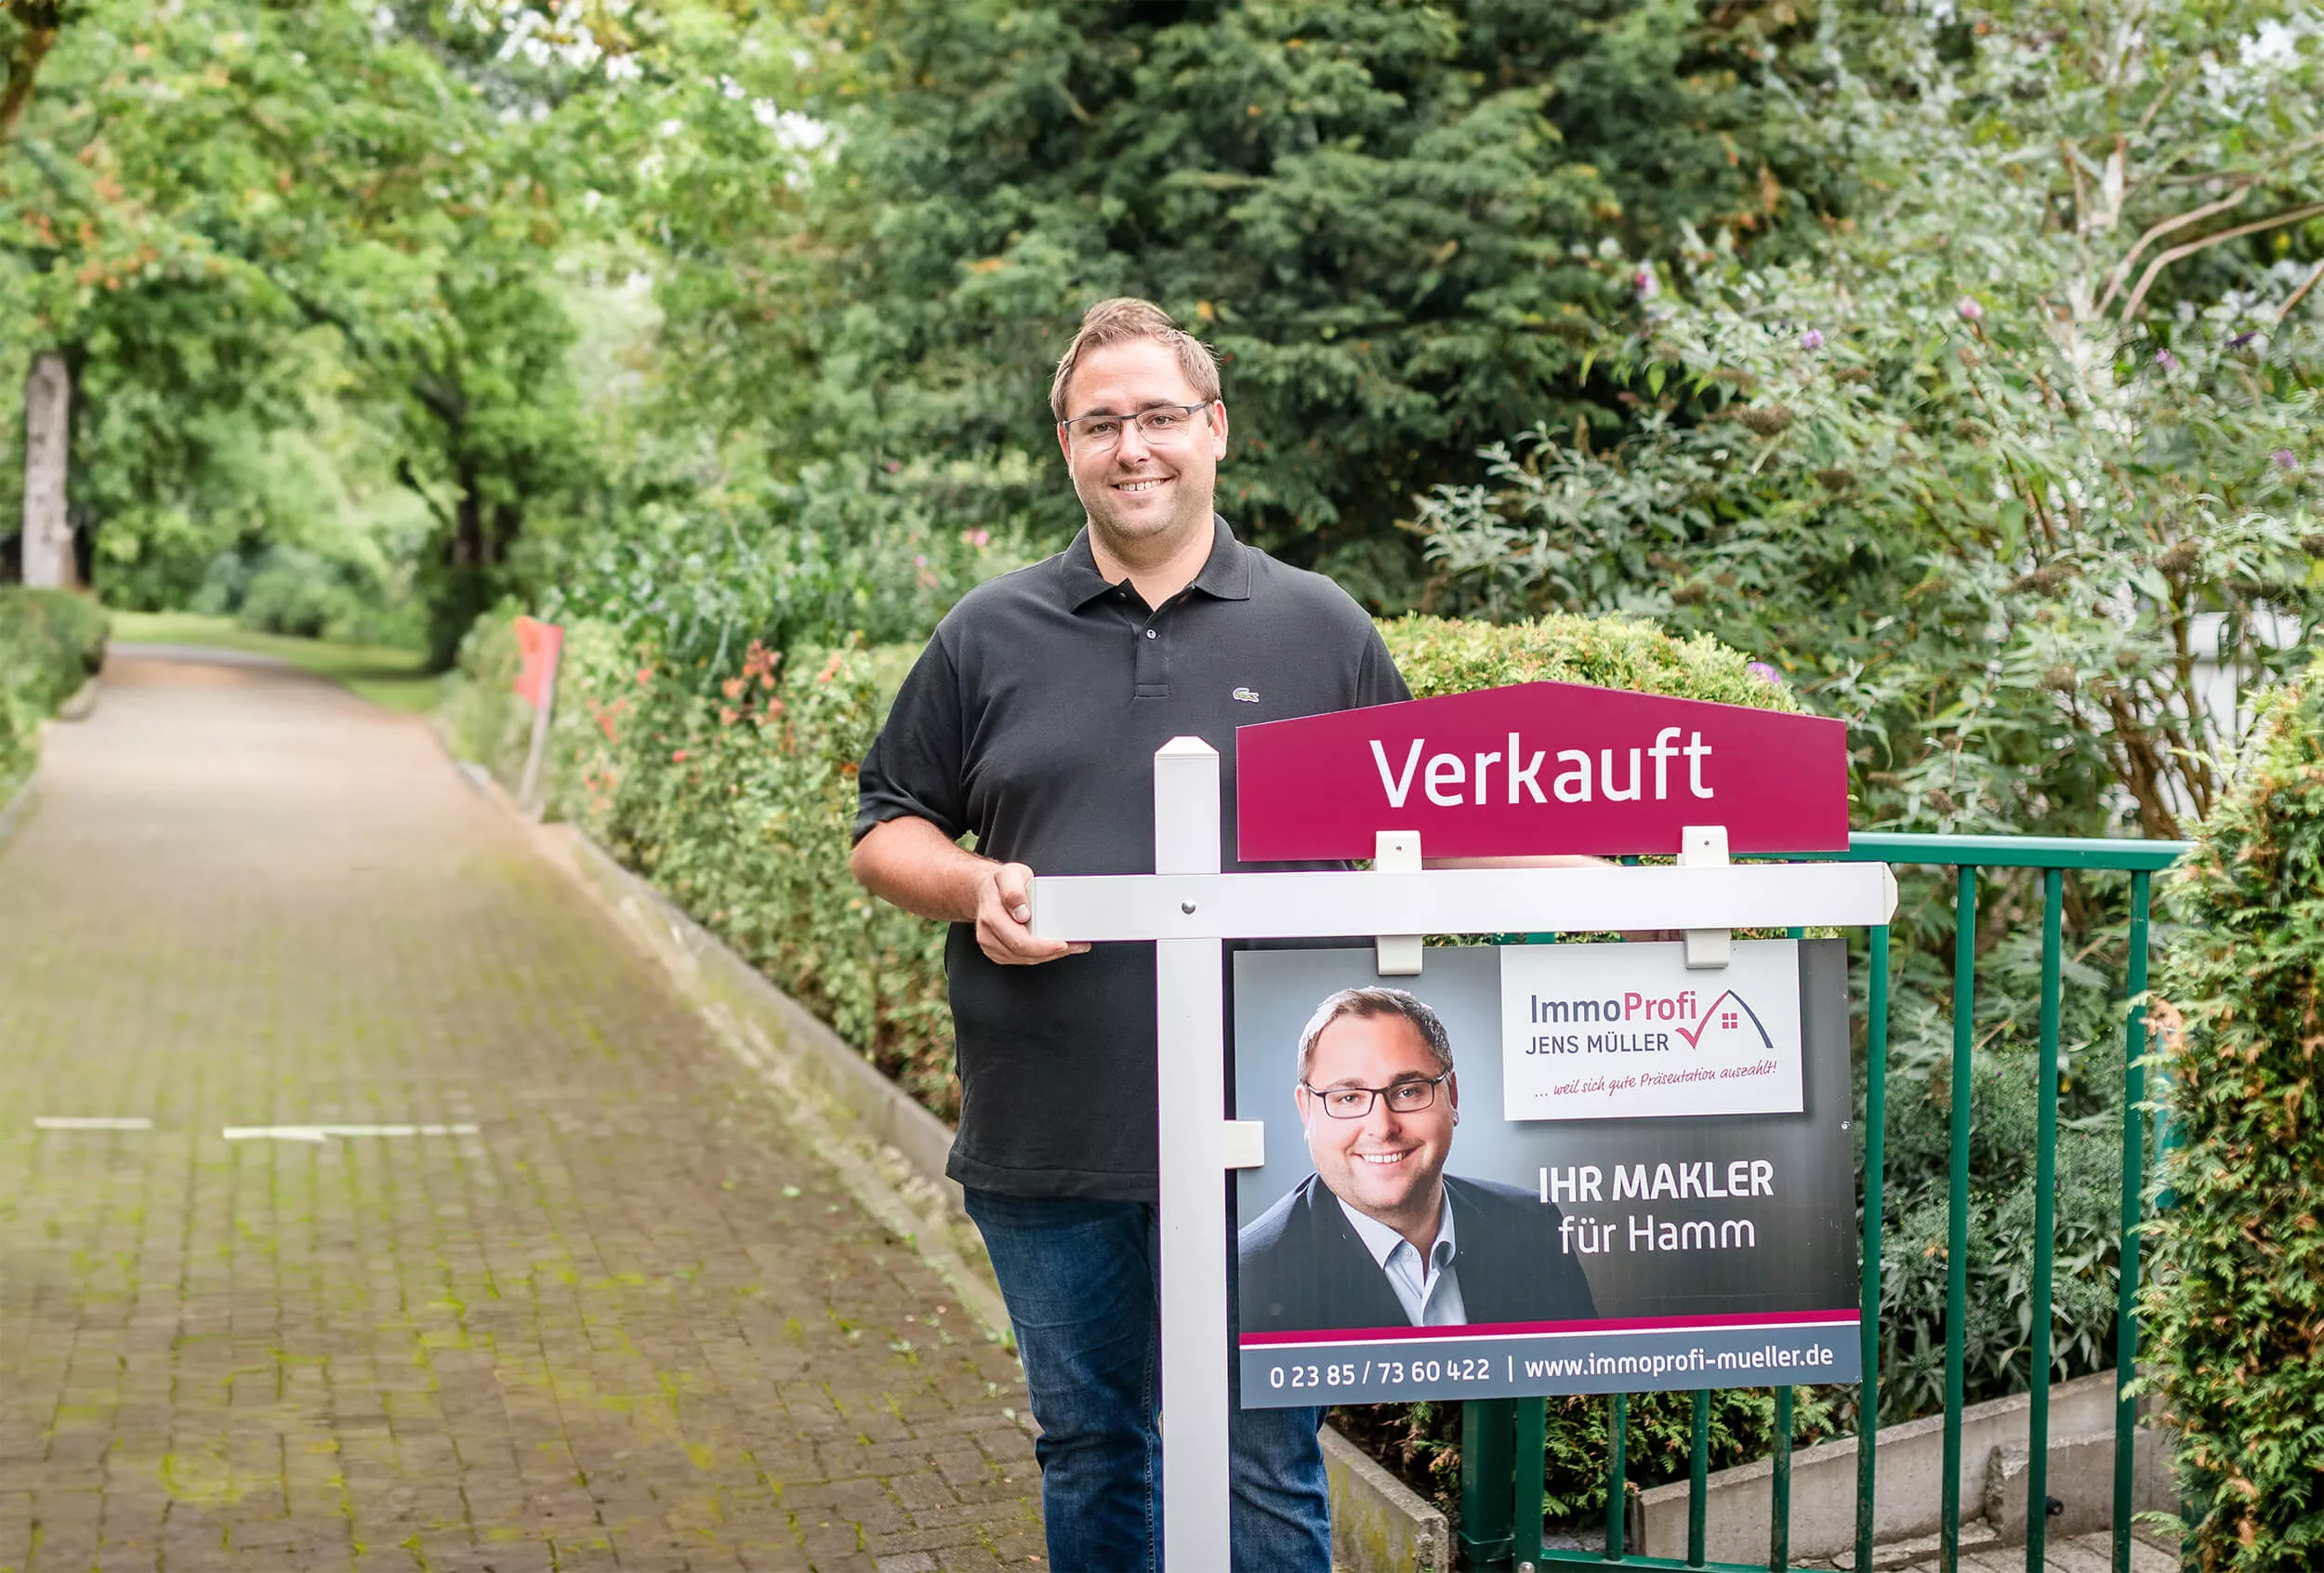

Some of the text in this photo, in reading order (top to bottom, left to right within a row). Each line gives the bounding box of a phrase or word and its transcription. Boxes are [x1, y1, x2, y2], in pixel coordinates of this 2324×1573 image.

[1368, 726, 1714, 808] Verkauft
[1530, 990, 1697, 1024] ImmoProfi
[1525, 1031, 1670, 1055] JENS MÜLLER
[1553, 1079, 1581, 1096] weil
[1581, 1077, 1605, 1093] sich
[1608, 1075, 1637, 1097] gute
[1640, 1066, 1716, 1087] Präsentation
[1719, 1060, 1777, 1079] auszahlt!
[1539, 1159, 1775, 1204] IHR MAKLER
[1558, 1214, 1756, 1255] für Hamm
[1270, 1366, 1285, 1389] 0
[1291, 1365, 1319, 1388] 23
[1327, 1364, 1355, 1385] 85
[1377, 1362, 1405, 1383] 73
[1411, 1360, 1441, 1382] 60
[1446, 1358, 1490, 1381] 422
[1525, 1343, 1834, 1378] www.immoprofi-mueller.de
